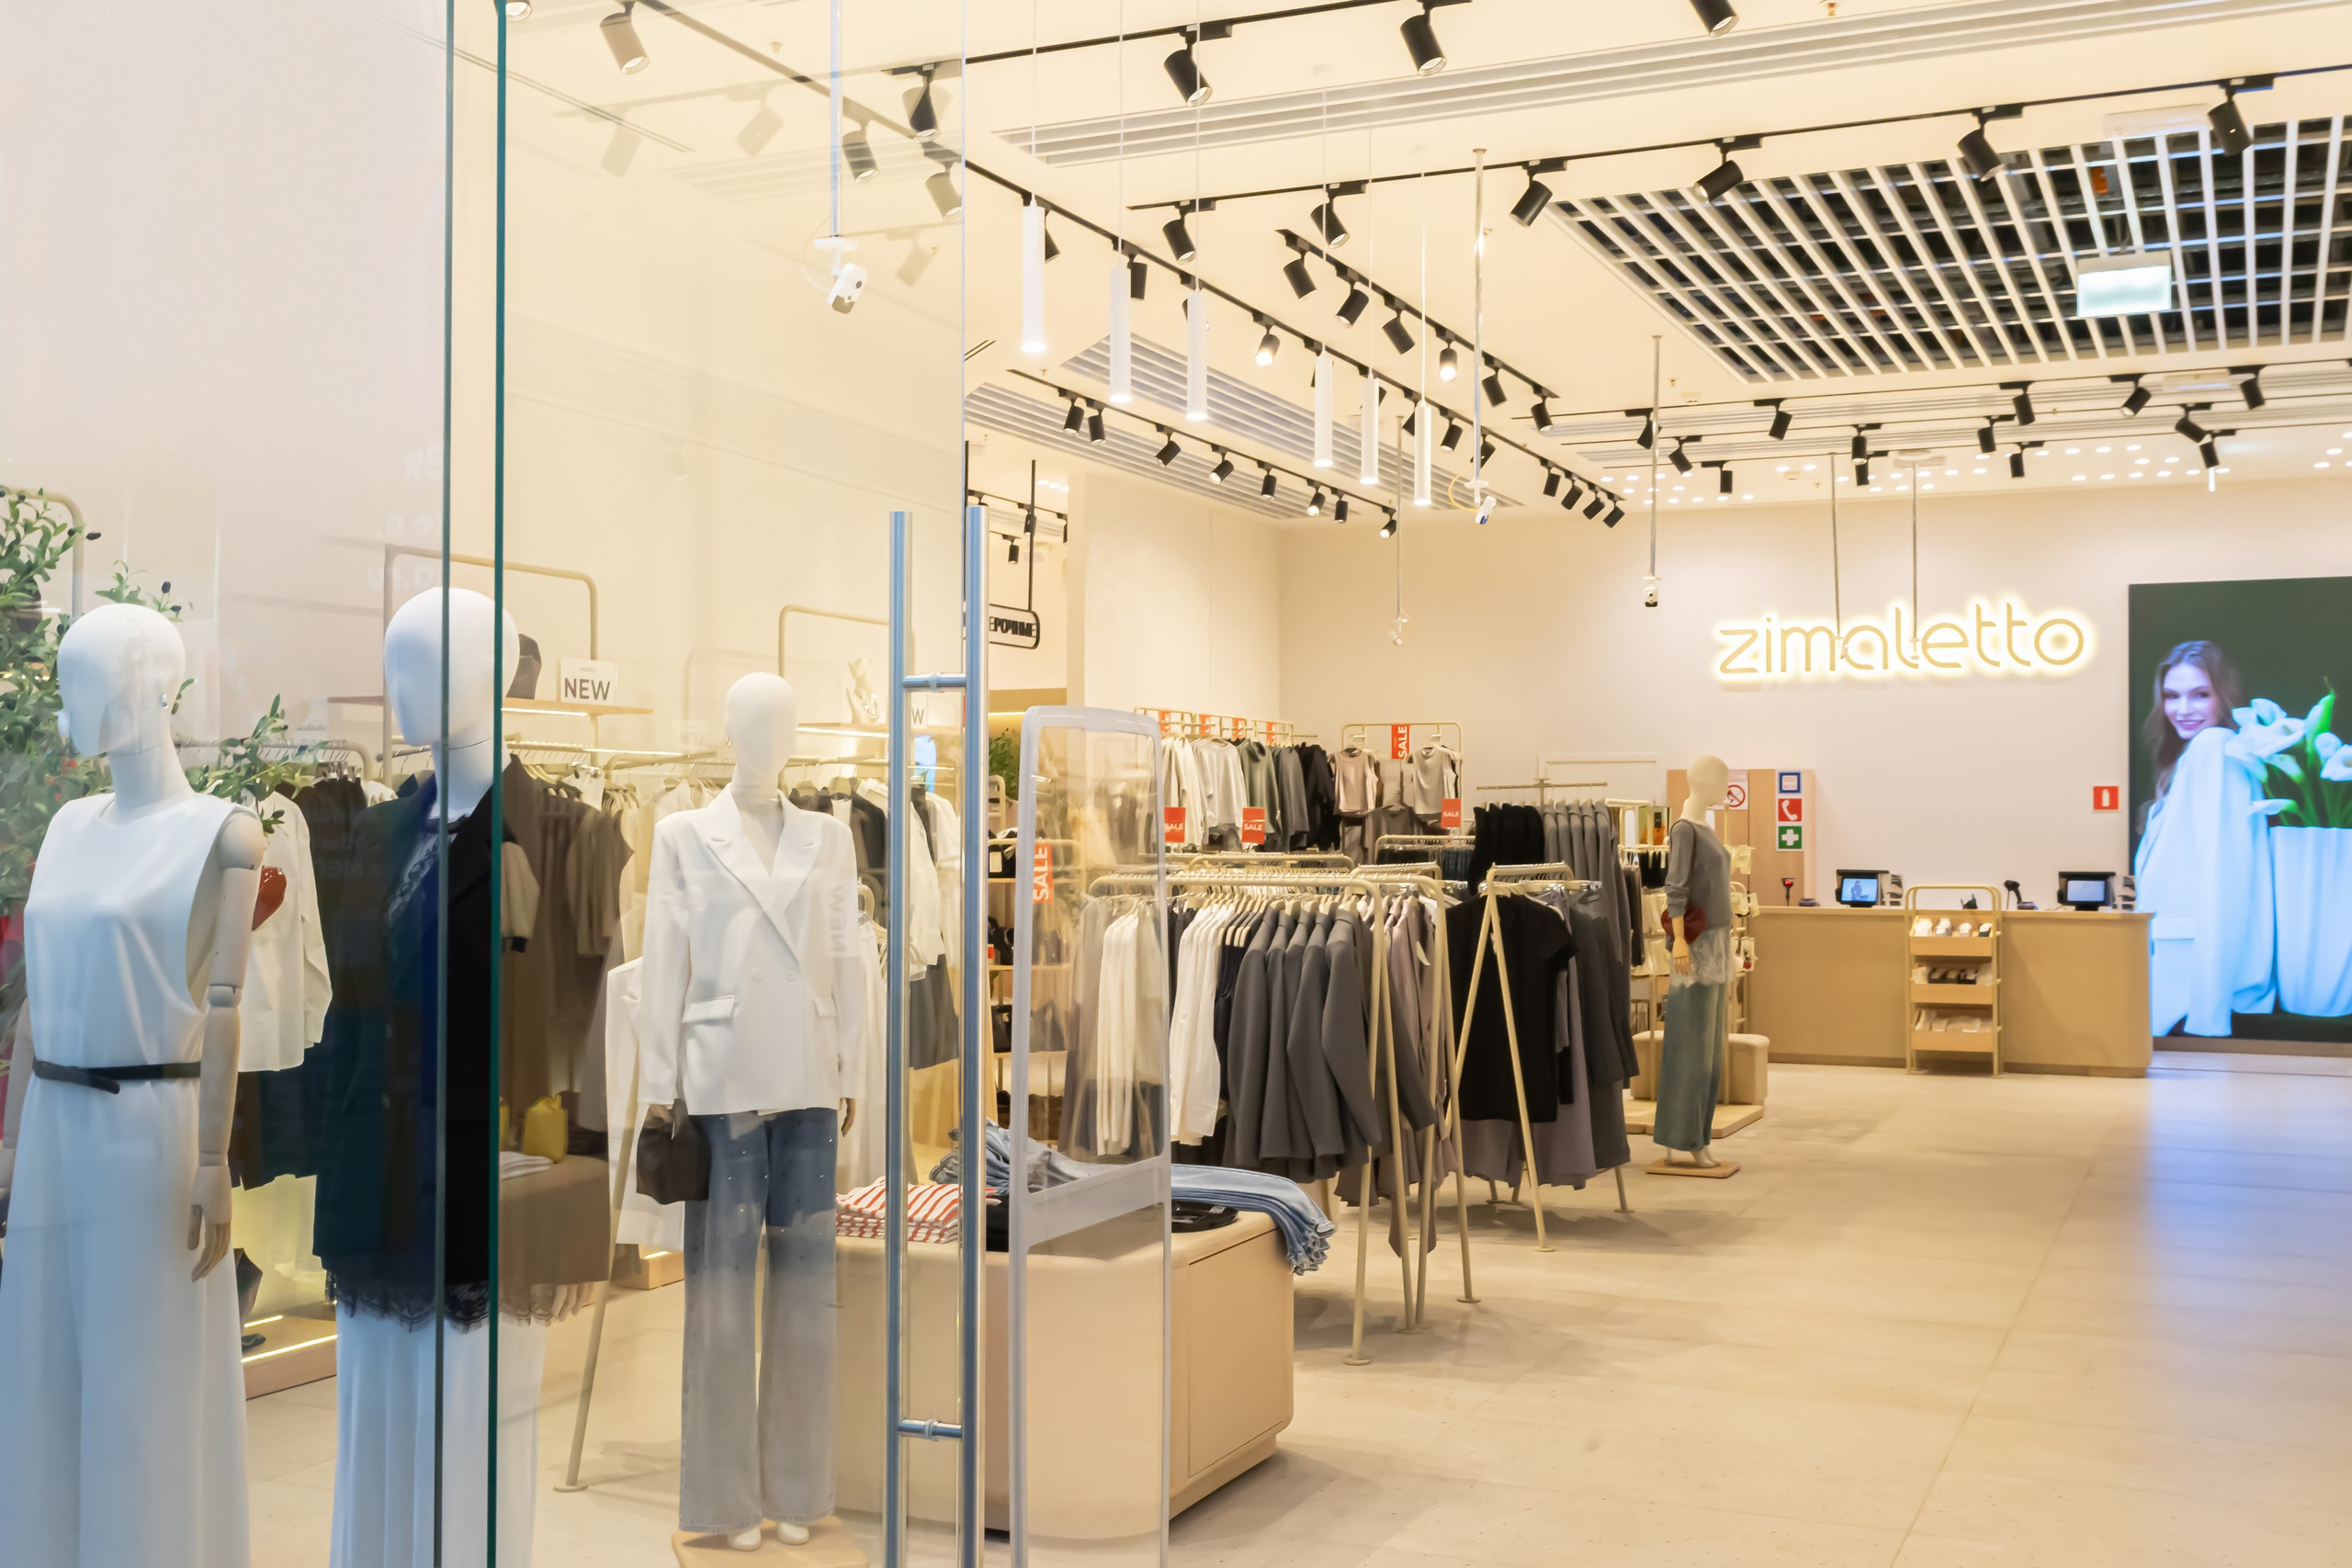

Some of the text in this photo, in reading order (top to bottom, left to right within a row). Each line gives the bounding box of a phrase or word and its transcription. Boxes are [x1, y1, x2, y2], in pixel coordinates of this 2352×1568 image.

[1719, 603, 2085, 674] zimaletto
[564, 677, 611, 701] NEW
[1397, 726, 1408, 758] SALE
[1164, 822, 1184, 830] SALE
[1243, 823, 1263, 831] SALE
[1033, 847, 1049, 901] SALE
